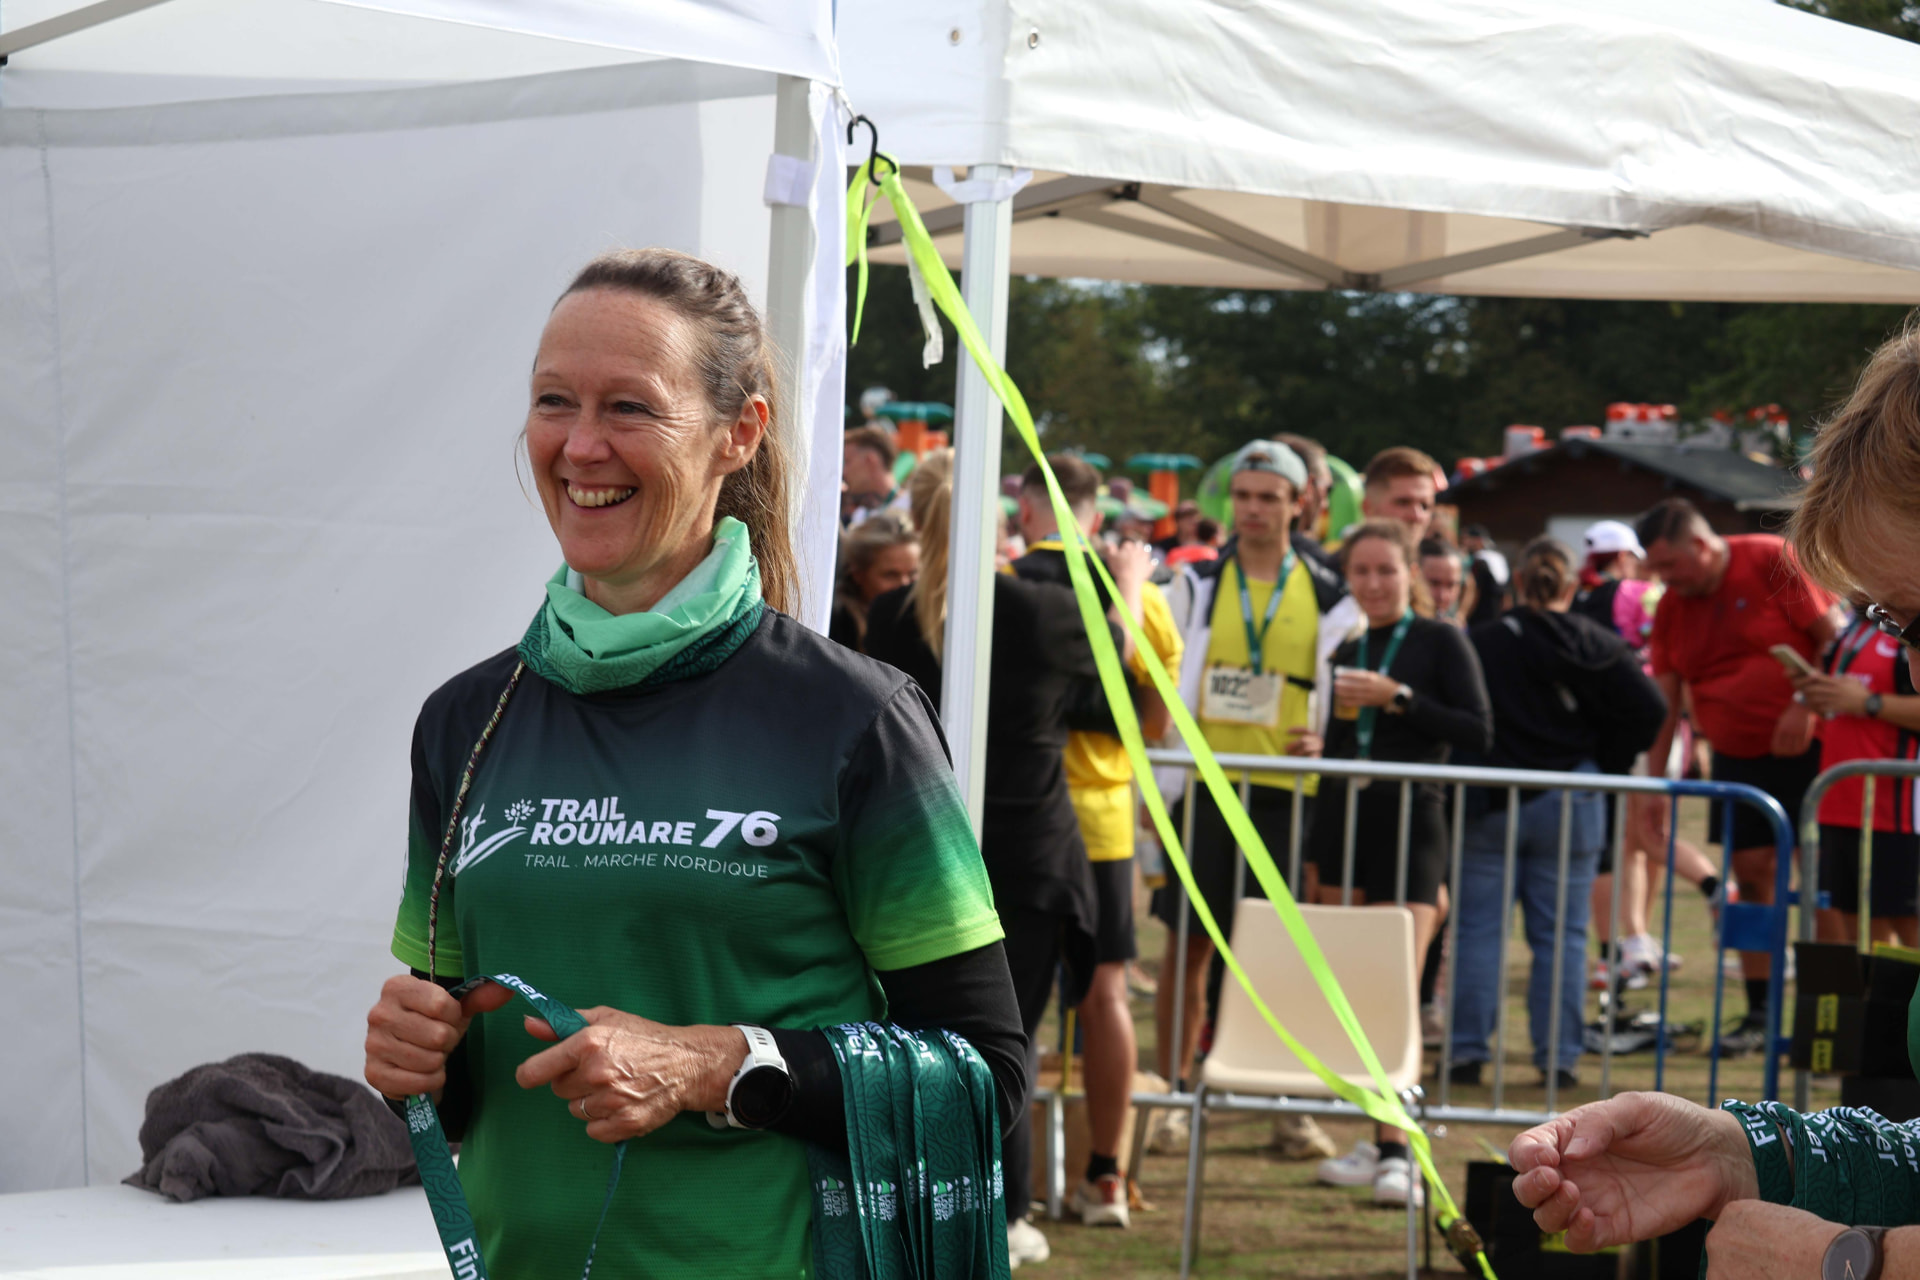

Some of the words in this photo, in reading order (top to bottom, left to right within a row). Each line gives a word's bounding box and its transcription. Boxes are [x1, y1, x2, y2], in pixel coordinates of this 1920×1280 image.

[540, 796, 625, 821] TRAIL
[529, 821, 696, 845] ROUMARE
[699, 808, 782, 849] 76
[524, 853, 570, 868] TRAIL
[583, 853, 658, 868] MARCHE
[663, 854, 769, 879] NORDIQUE
